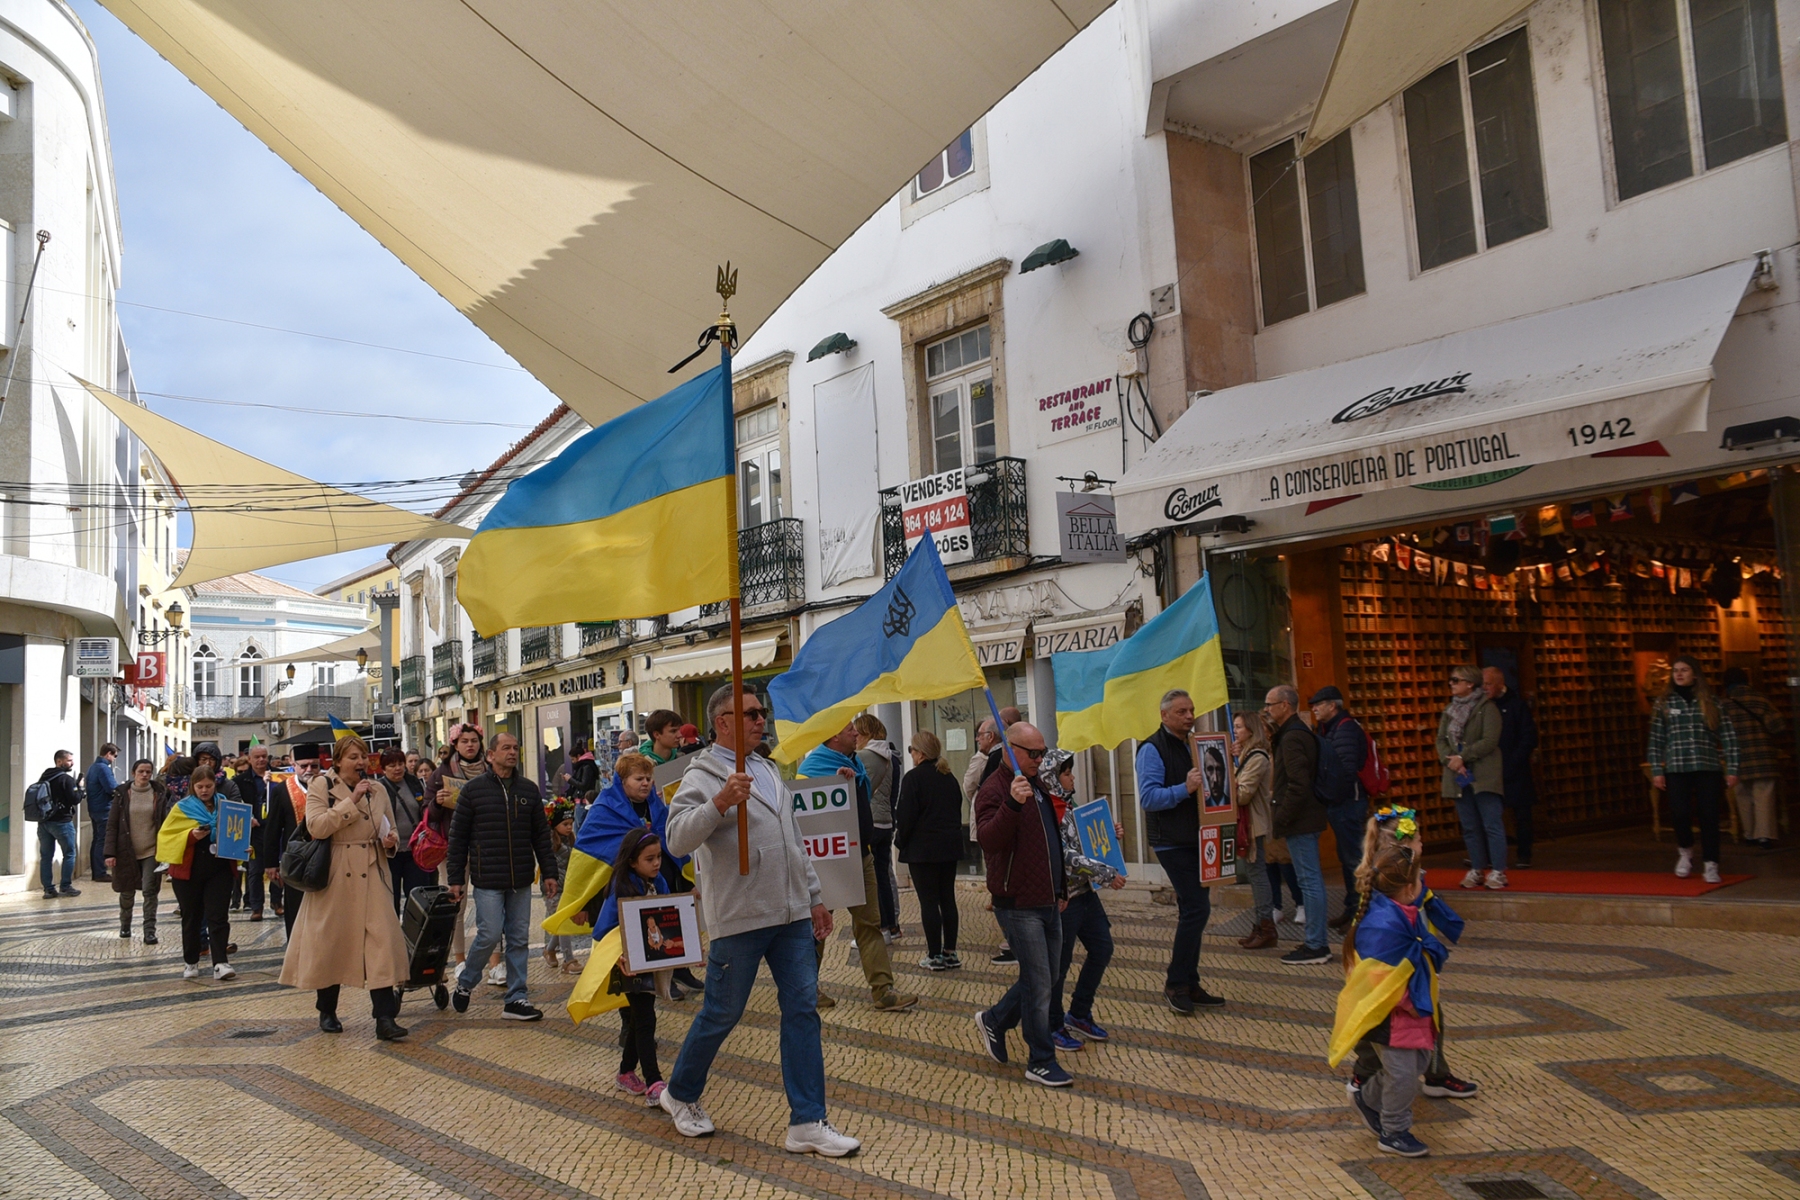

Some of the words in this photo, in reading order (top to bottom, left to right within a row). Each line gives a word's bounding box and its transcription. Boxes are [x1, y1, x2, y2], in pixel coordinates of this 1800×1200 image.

[1039, 378, 1112, 411] RESTAURANT
[1069, 401, 1084, 412] AND
[1332, 371, 1472, 424] Comur
[1051, 406, 1101, 432] TERRACE
[1094, 418, 1118, 430] FLOOR
[1568, 418, 1636, 447] 1942
[1285, 455, 1388, 497] CONSERVEIRA
[1394, 450, 1416, 478] DE
[903, 471, 962, 503] VENDE-SE
[1164, 484, 1222, 521] Comur
[905, 514, 921, 533] 964
[924, 508, 941, 527] 184
[945, 503, 964, 522] 124
[1070, 517, 1116, 534] BELLA
[1068, 534, 1119, 551] ITALIA
[978, 642, 1017, 664] NTE
[1036, 626, 1120, 656] PIZARIA
[138, 655, 158, 679] B
[506, 682, 555, 704] FARMÁCIA
[793, 788, 847, 812] ADO
[1203, 828, 1217, 839] NEVER
